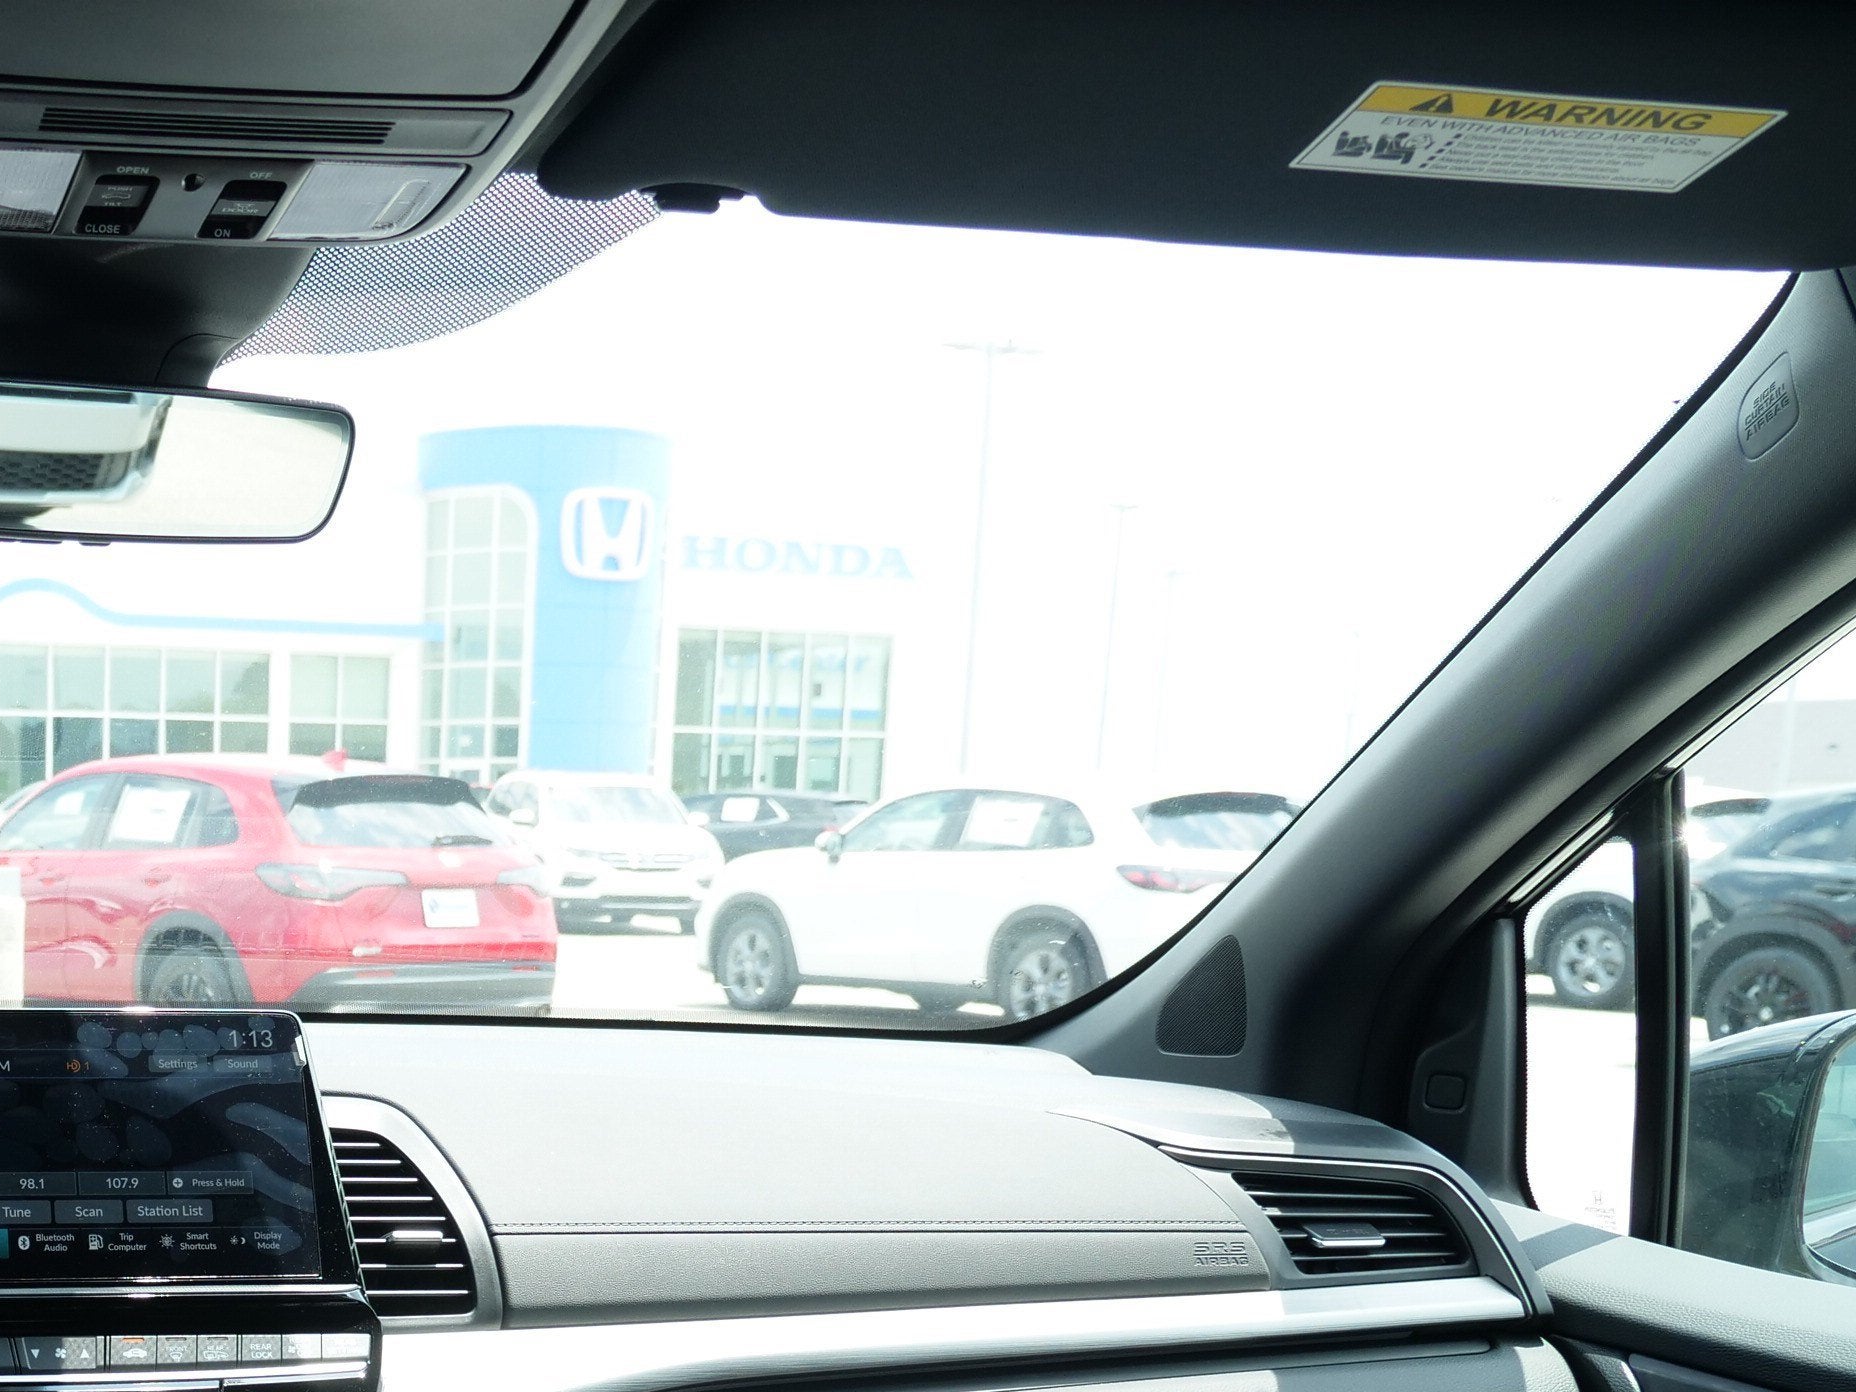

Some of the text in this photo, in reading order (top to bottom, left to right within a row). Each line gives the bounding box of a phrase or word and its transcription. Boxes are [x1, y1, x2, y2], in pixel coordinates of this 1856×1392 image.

[1484, 97, 1712, 132] WARNING
[1380, 115, 1701, 147] EVEN WITH ADVANCED AIR BAGS
[116, 166, 150, 175] OPEN
[249, 171, 273, 180] OFF
[84, 223, 121, 234] CLOSE
[214, 229, 231, 238] ON
[681, 534, 915, 582] HONDA
[228, 1029, 274, 1048] 1:13
[158, 1059, 198, 1070] Settings
[227, 1059, 259, 1069] Sound
[19, 1178, 45, 1189] 98.1
[105, 1178, 139, 1190] 107.9
[192, 1178, 245, 1187] Press & Hold
[2, 1206, 31, 1218] Tune
[75, 1206, 104, 1218] Scan
[137, 1205, 204, 1217] Station List
[35, 1233, 75, 1242] Bluetooth
[119, 1232, 134, 1243] Trip
[186, 1232, 209, 1241] Smart
[254, 1231, 282, 1242] Display
[44, 1243, 68, 1252] Audio
[108, 1243, 147, 1253] Computer
[179, 1242, 217, 1251] Shortcuts
[257, 1241, 281, 1250] Mode
[1194, 1241, 1246, 1253] SRS
[1194, 1256, 1249, 1267] AIRBAG
[250, 1343, 272, 1351] REAR
[251, 1351, 273, 1359] LOCK
